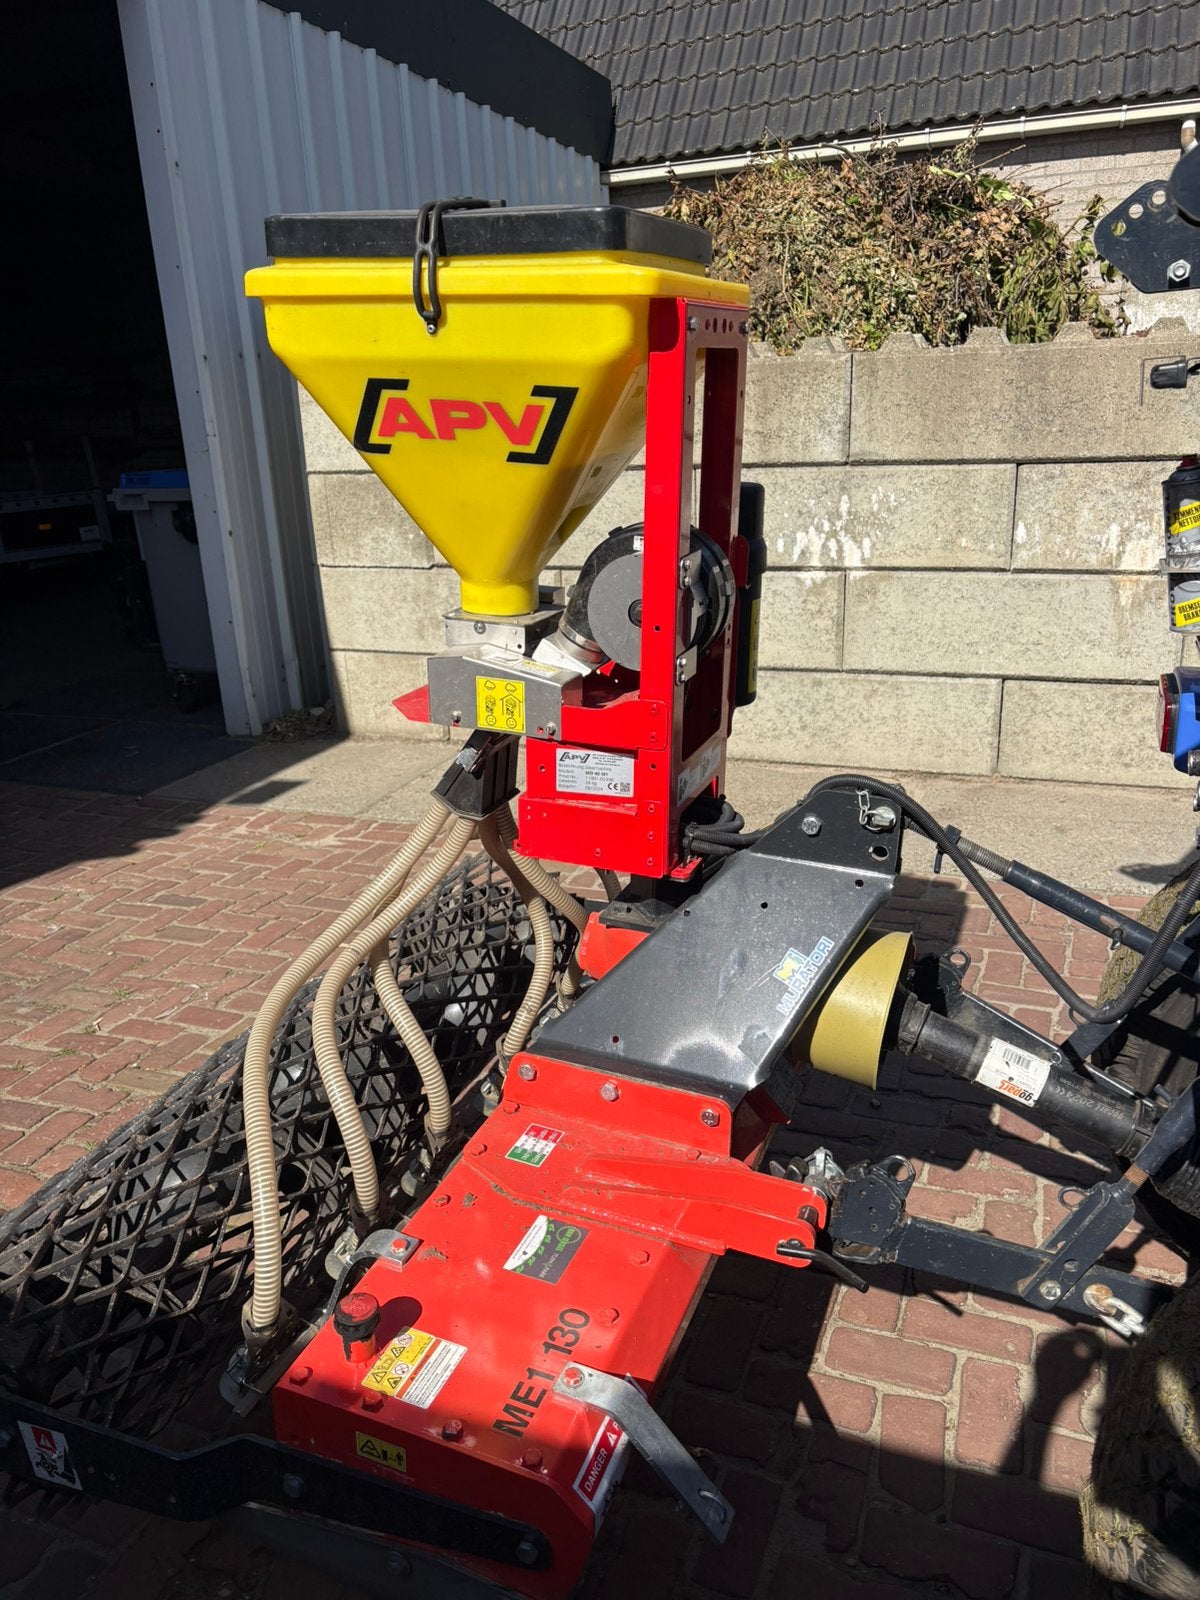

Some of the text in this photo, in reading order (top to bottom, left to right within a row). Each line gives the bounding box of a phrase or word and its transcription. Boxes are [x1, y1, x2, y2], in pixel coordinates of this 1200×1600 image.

[776, 936, 835, 1016] MURATORI
[1000, 1079, 1034, 1102] gopart
[542, 1308, 590, 1355] 130
[584, 1447, 608, 1492] DANGER
